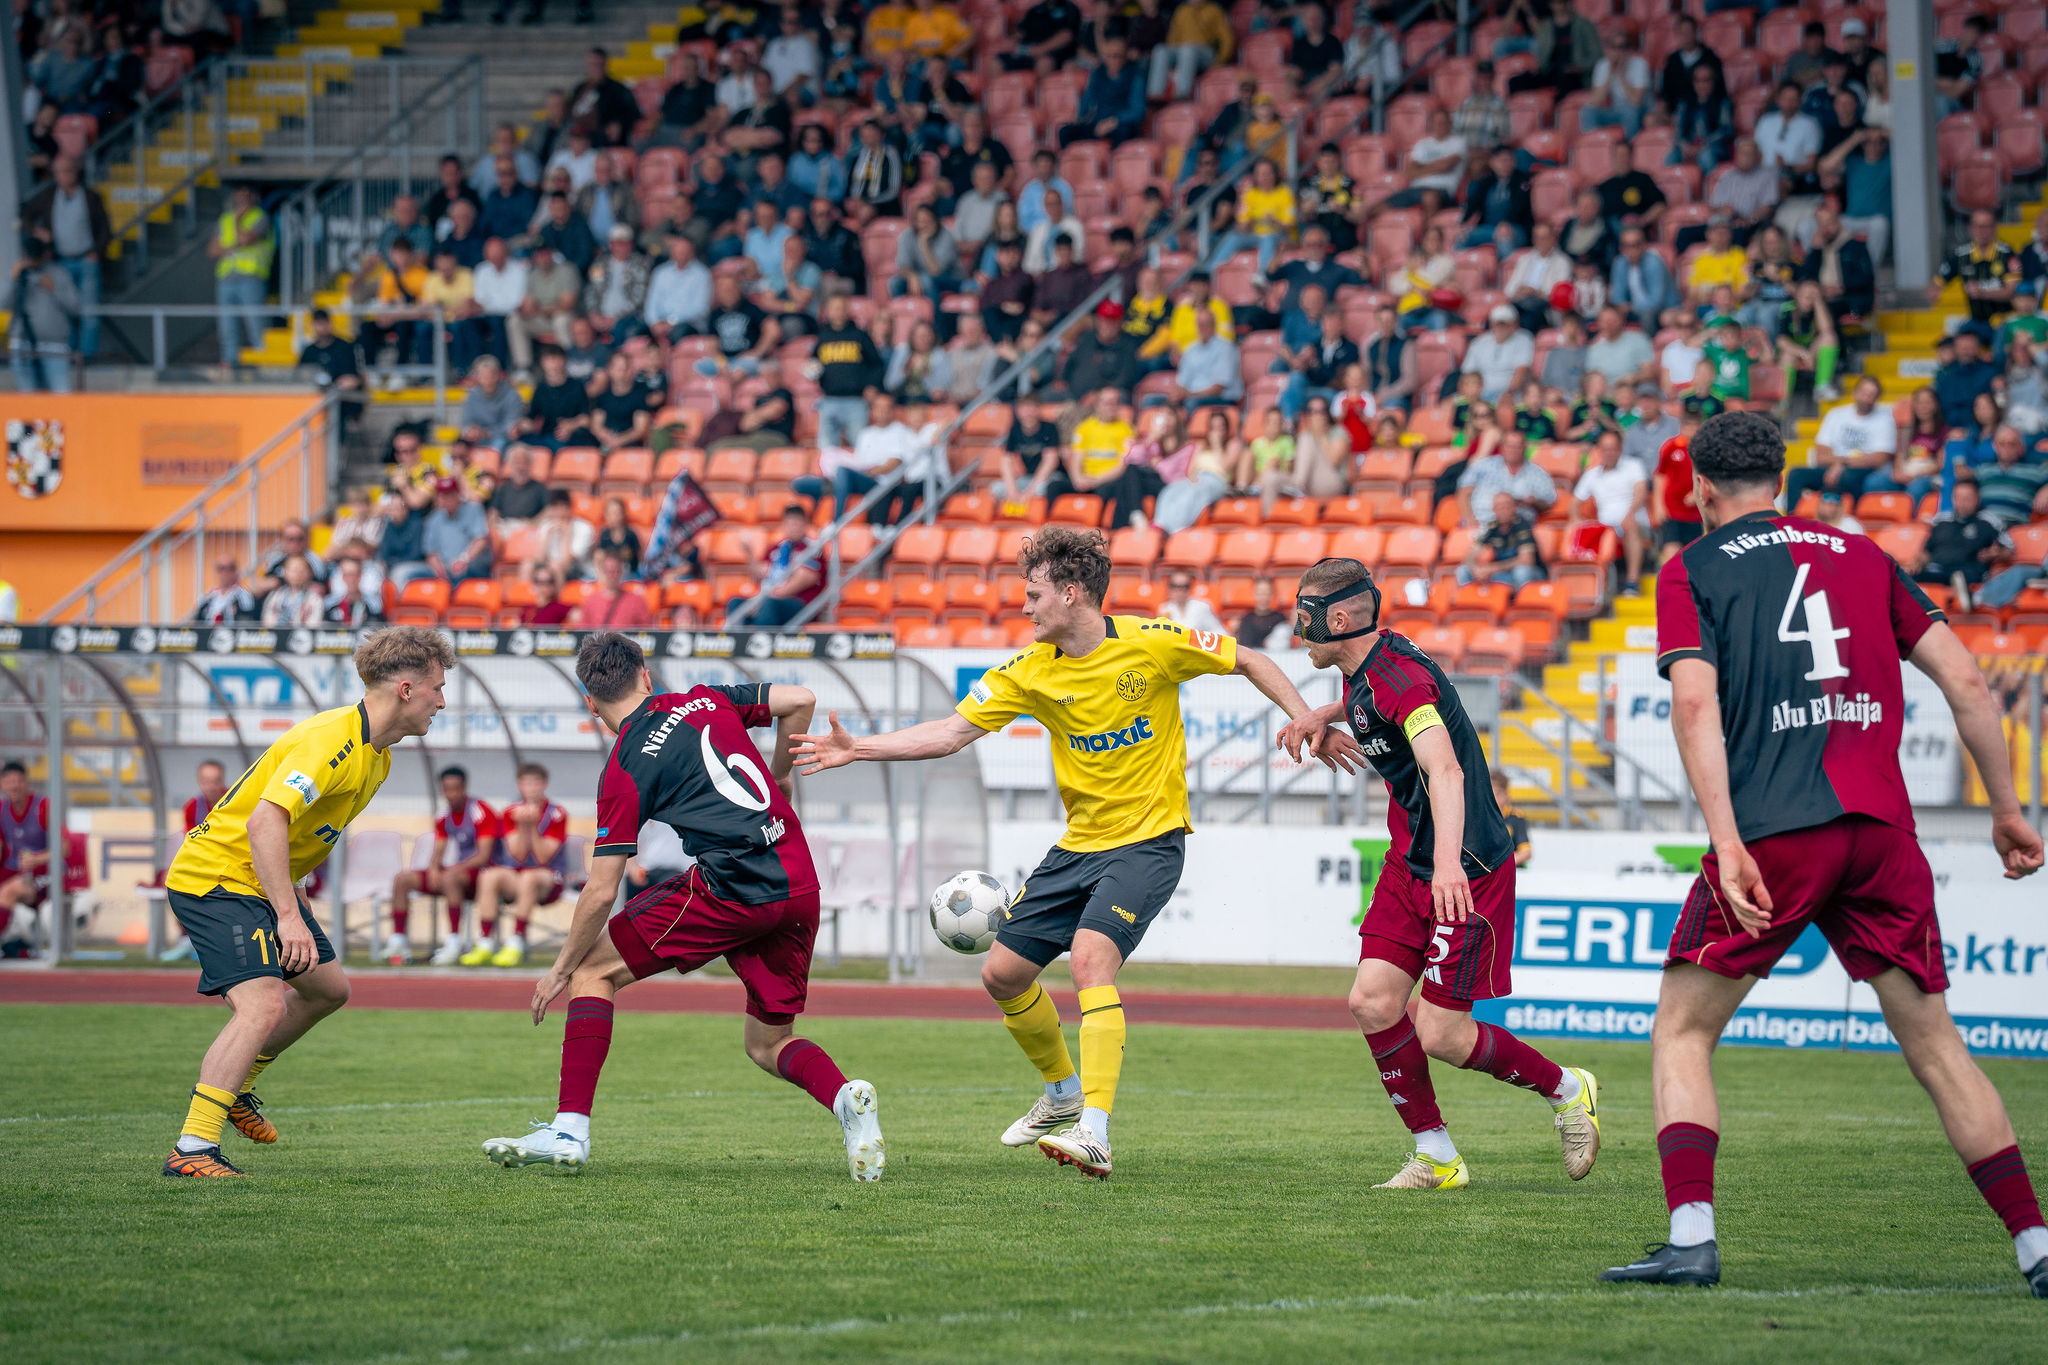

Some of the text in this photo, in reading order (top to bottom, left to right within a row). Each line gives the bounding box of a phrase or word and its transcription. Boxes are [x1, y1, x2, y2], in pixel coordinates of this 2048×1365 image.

[1719, 525, 1847, 560] Nürnberg
[1777, 563, 1850, 681] 4
[641, 697, 717, 758] Nürnberg
[1408, 711, 1437, 729] RESPECT
[1809, 693, 1833, 726] El
[1834, 692, 1882, 731] Haija
[1067, 715, 1154, 752] maxit
[1359, 738, 1391, 756] raft
[700, 724, 771, 812] 6
[760, 815, 785, 846] Fuchs
[1111, 904, 1136, 923] capelli
[1428, 925, 1454, 963] 5
